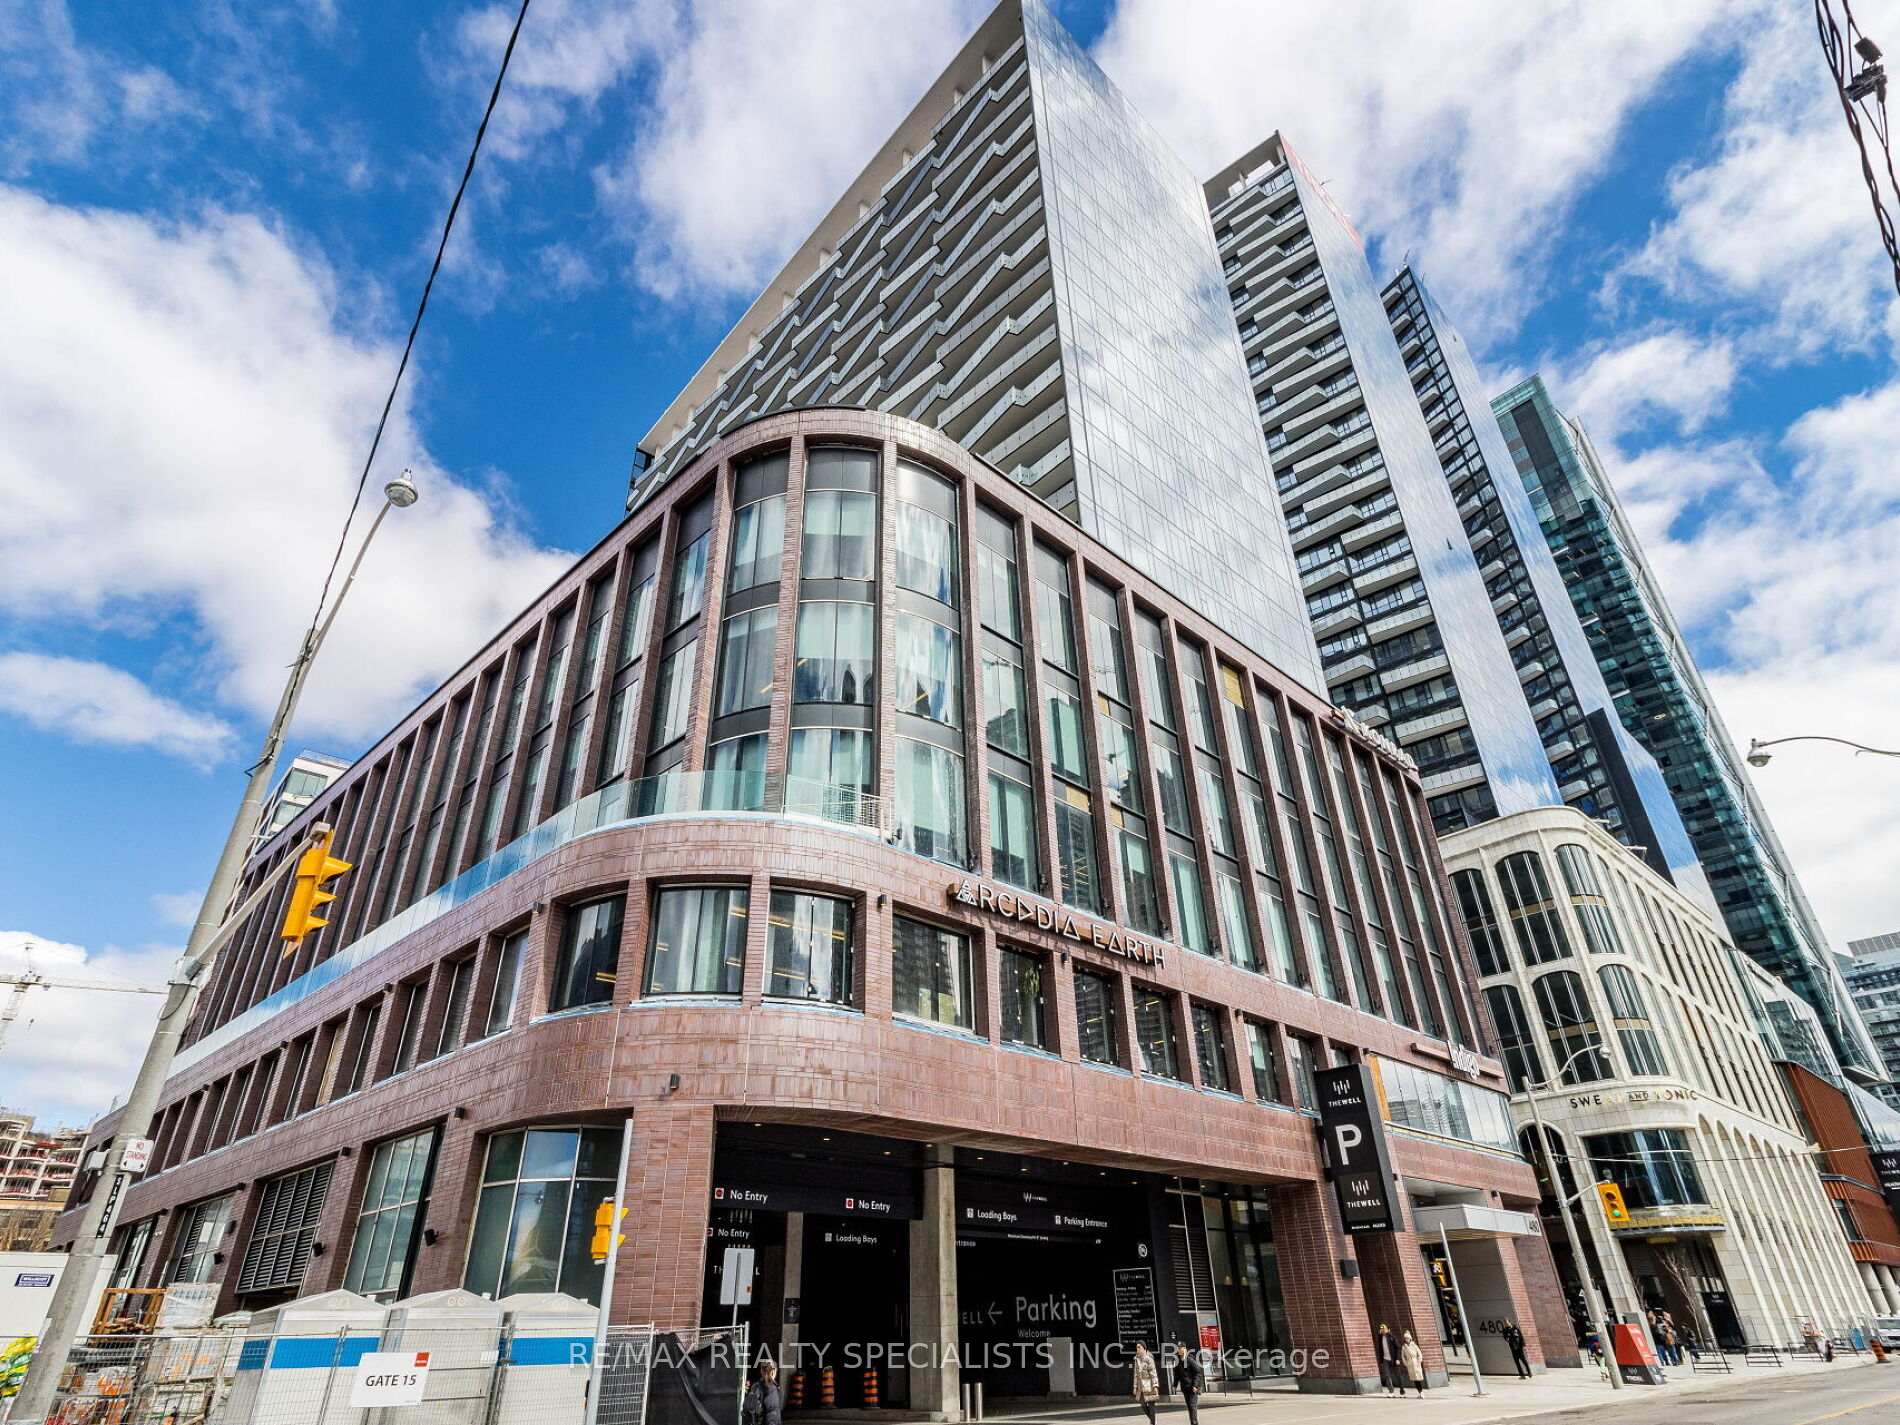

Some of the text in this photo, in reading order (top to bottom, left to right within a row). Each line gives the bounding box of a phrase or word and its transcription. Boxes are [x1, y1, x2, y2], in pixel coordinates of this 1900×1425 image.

[957, 879, 1165, 969] ARCADIA EARTH
[1335, 1124, 1362, 1165] P
[730, 1189, 768, 1204] No Entry
[858, 1200, 891, 1214] No Entry
[977, 1210, 1017, 1224] Loading Bays
[1064, 1215, 1108, 1228] Parking Entrance
[718, 1228, 751, 1240] No Entry
[836, 1234, 878, 1245] Loading Bays
[1016, 1293, 1097, 1328] Parking
[961, 1311, 984, 1325] ELL
[1017, 1328, 1051, 1338] Welcome
[1479, 1320, 1504, 1334] 480
[365, 1374, 417, 1387] GATE 15
